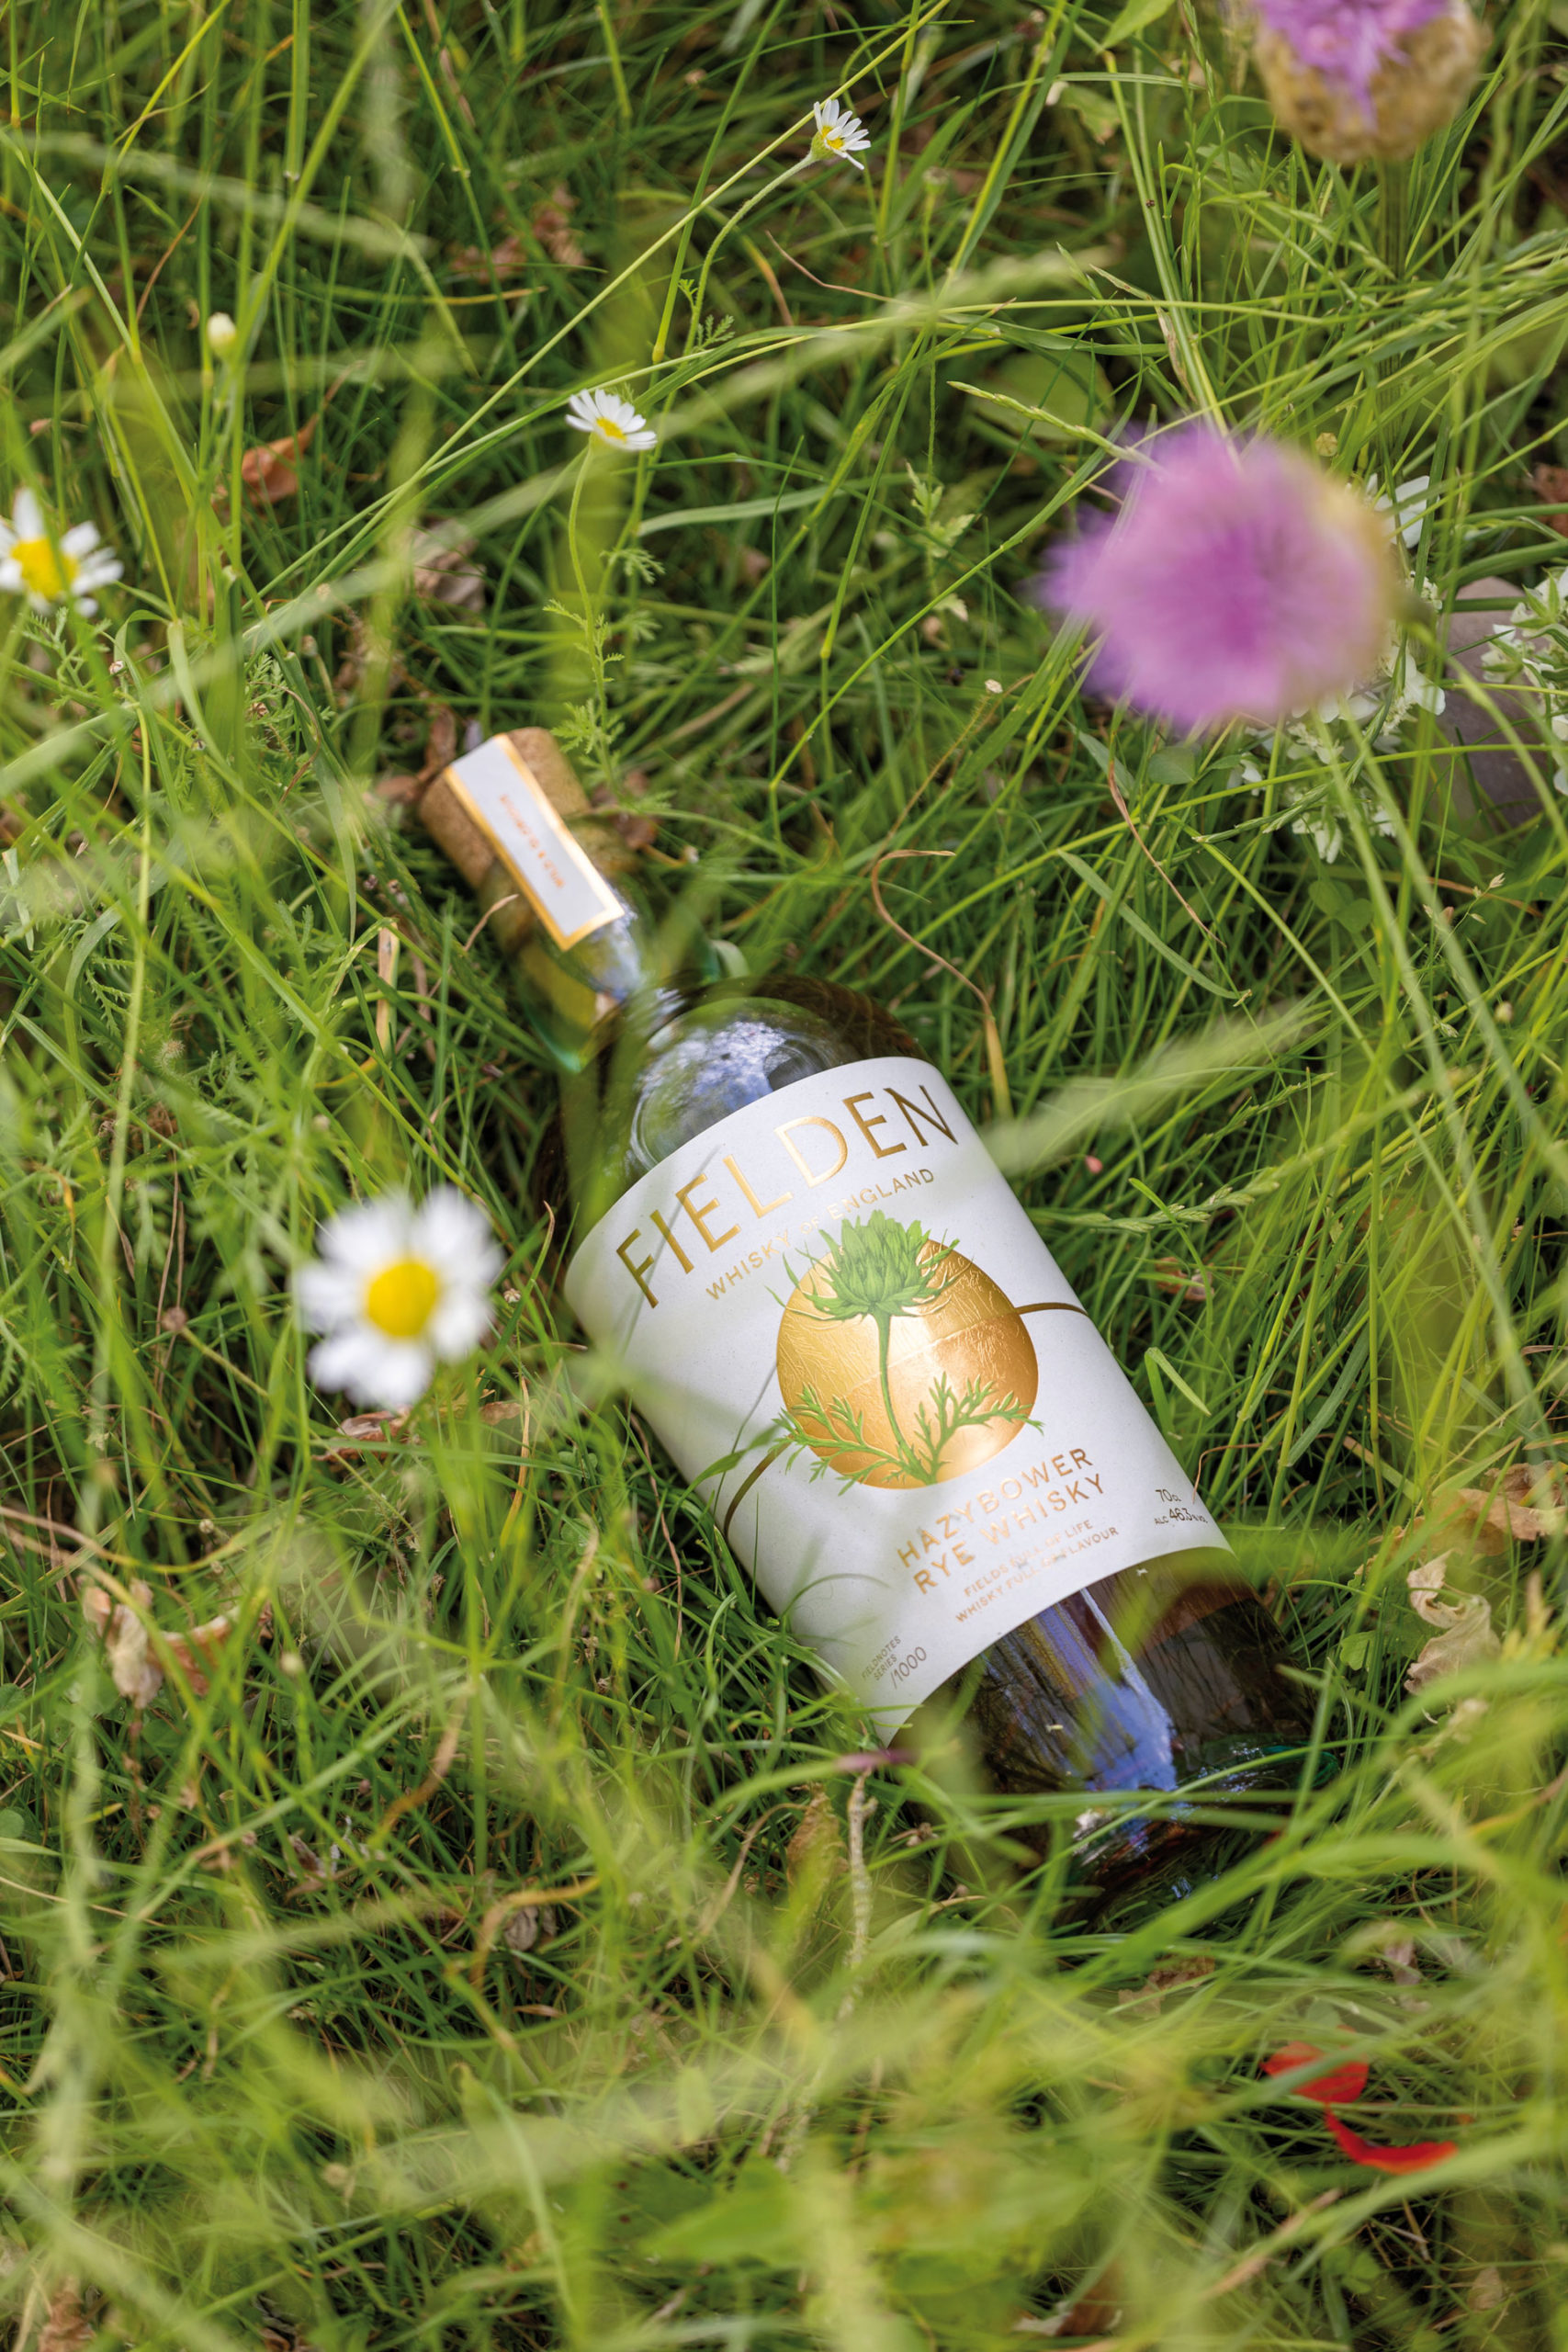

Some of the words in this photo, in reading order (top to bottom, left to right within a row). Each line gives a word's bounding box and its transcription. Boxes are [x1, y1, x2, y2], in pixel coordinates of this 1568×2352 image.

[616, 1084, 958, 1308] FIELDEN
[705, 1229, 791, 1300] WHISKY
[799, 1216, 819, 1235] OF
[827, 1169, 934, 1220] ENGLAND
[897, 1448, 1093, 1567] HAZYBOWER
[913, 1541, 976, 1594] RYE
[980, 1473, 1103, 1545] WHISKY
[955, 1586, 1004, 1623] WHISKY
[1006, 1566, 1040, 1589] FULL
[1059, 1526, 1119, 1558] FLAVOUR
[964, 1564, 1009, 1597] FIELDS
[1010, 1545, 1044, 1567] FULL
[1045, 1533, 1062, 1548] OF
[1065, 1520, 1094, 1539] LIFE
[862, 1635, 901, 1680] FIELDNOTES
[874, 1654, 897, 1681] SERIES
[890, 1646, 927, 1690] /1000
